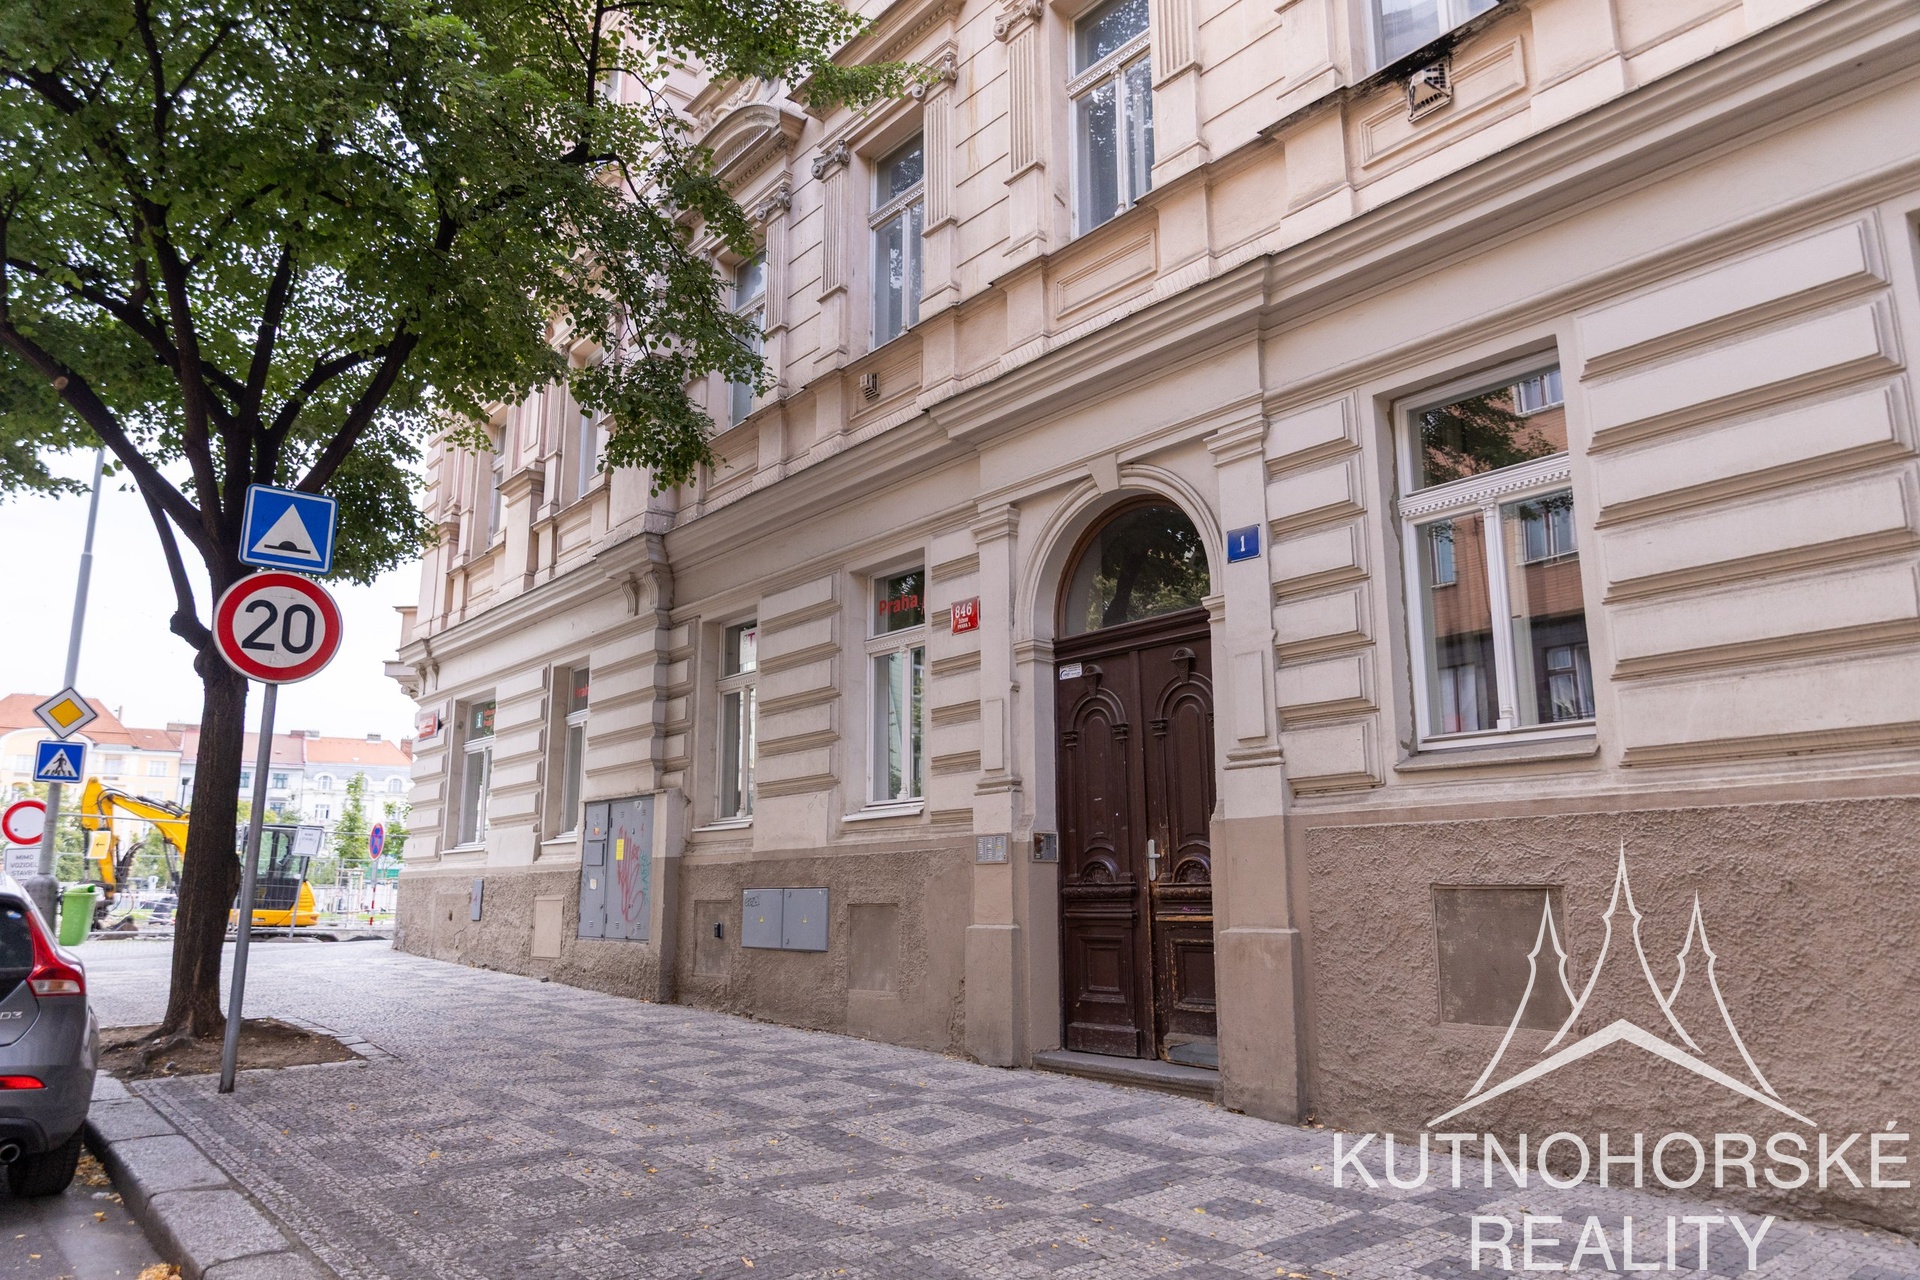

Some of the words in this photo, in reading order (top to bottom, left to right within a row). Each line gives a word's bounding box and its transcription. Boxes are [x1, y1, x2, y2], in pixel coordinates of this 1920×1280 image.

[1240, 535, 1246, 552] 1
[879, 594, 918, 616] Praha
[955, 603, 972, 619] 846
[241, 599, 316, 655] 20
[0, 1011, 23, 1020] D3
